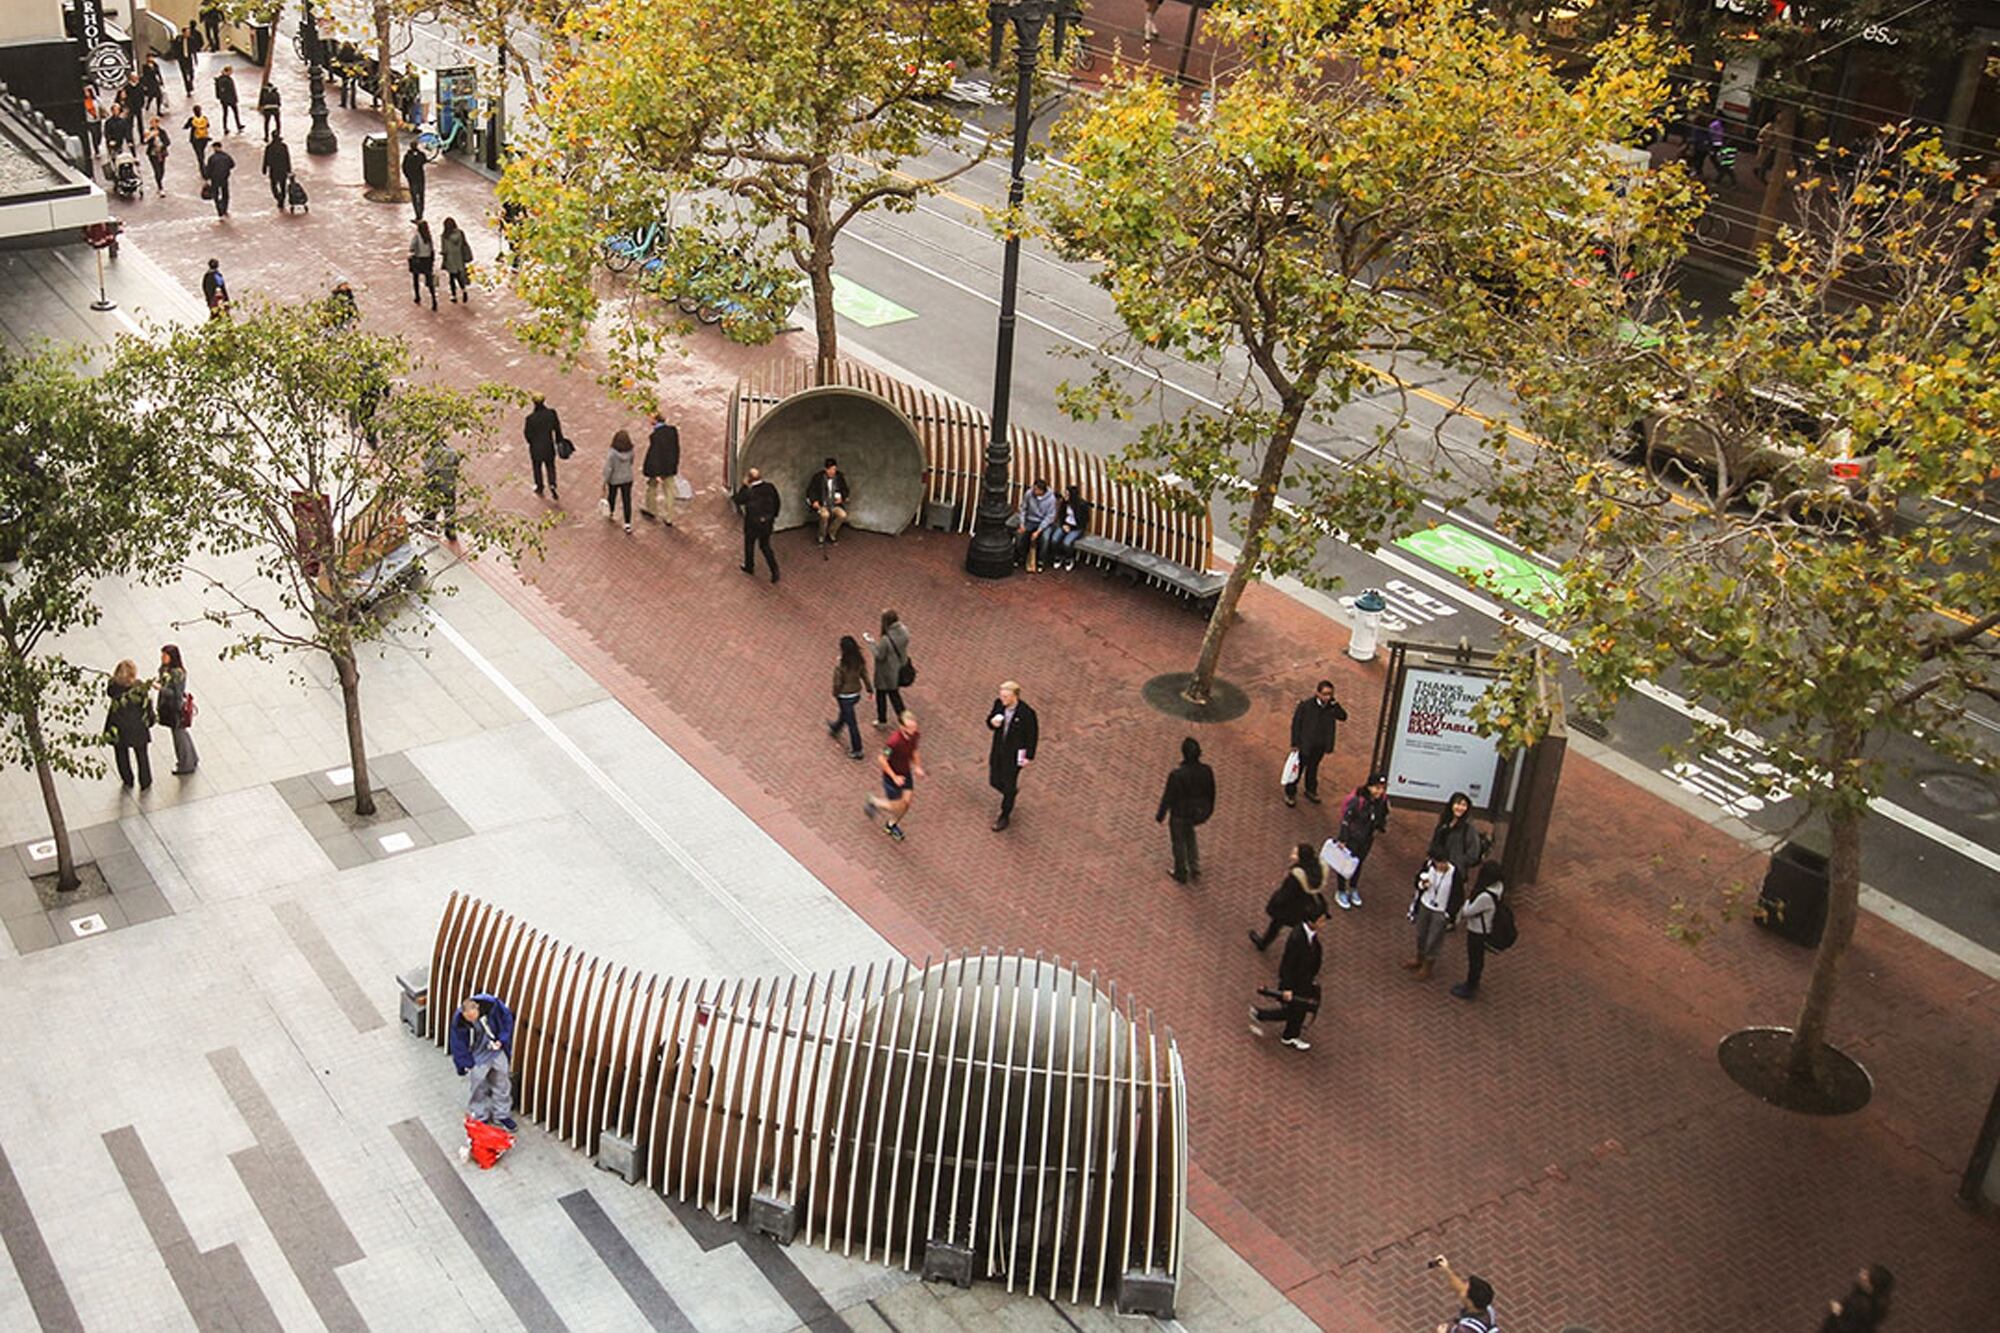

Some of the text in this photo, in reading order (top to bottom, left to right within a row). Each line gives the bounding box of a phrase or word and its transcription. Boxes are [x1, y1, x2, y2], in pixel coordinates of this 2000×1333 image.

[1414, 687, 1438, 697] FOR
[1416, 680, 1464, 693] THANKS
[1413, 695, 1454, 707] US THE
[1410, 710, 1445, 721] MOST
